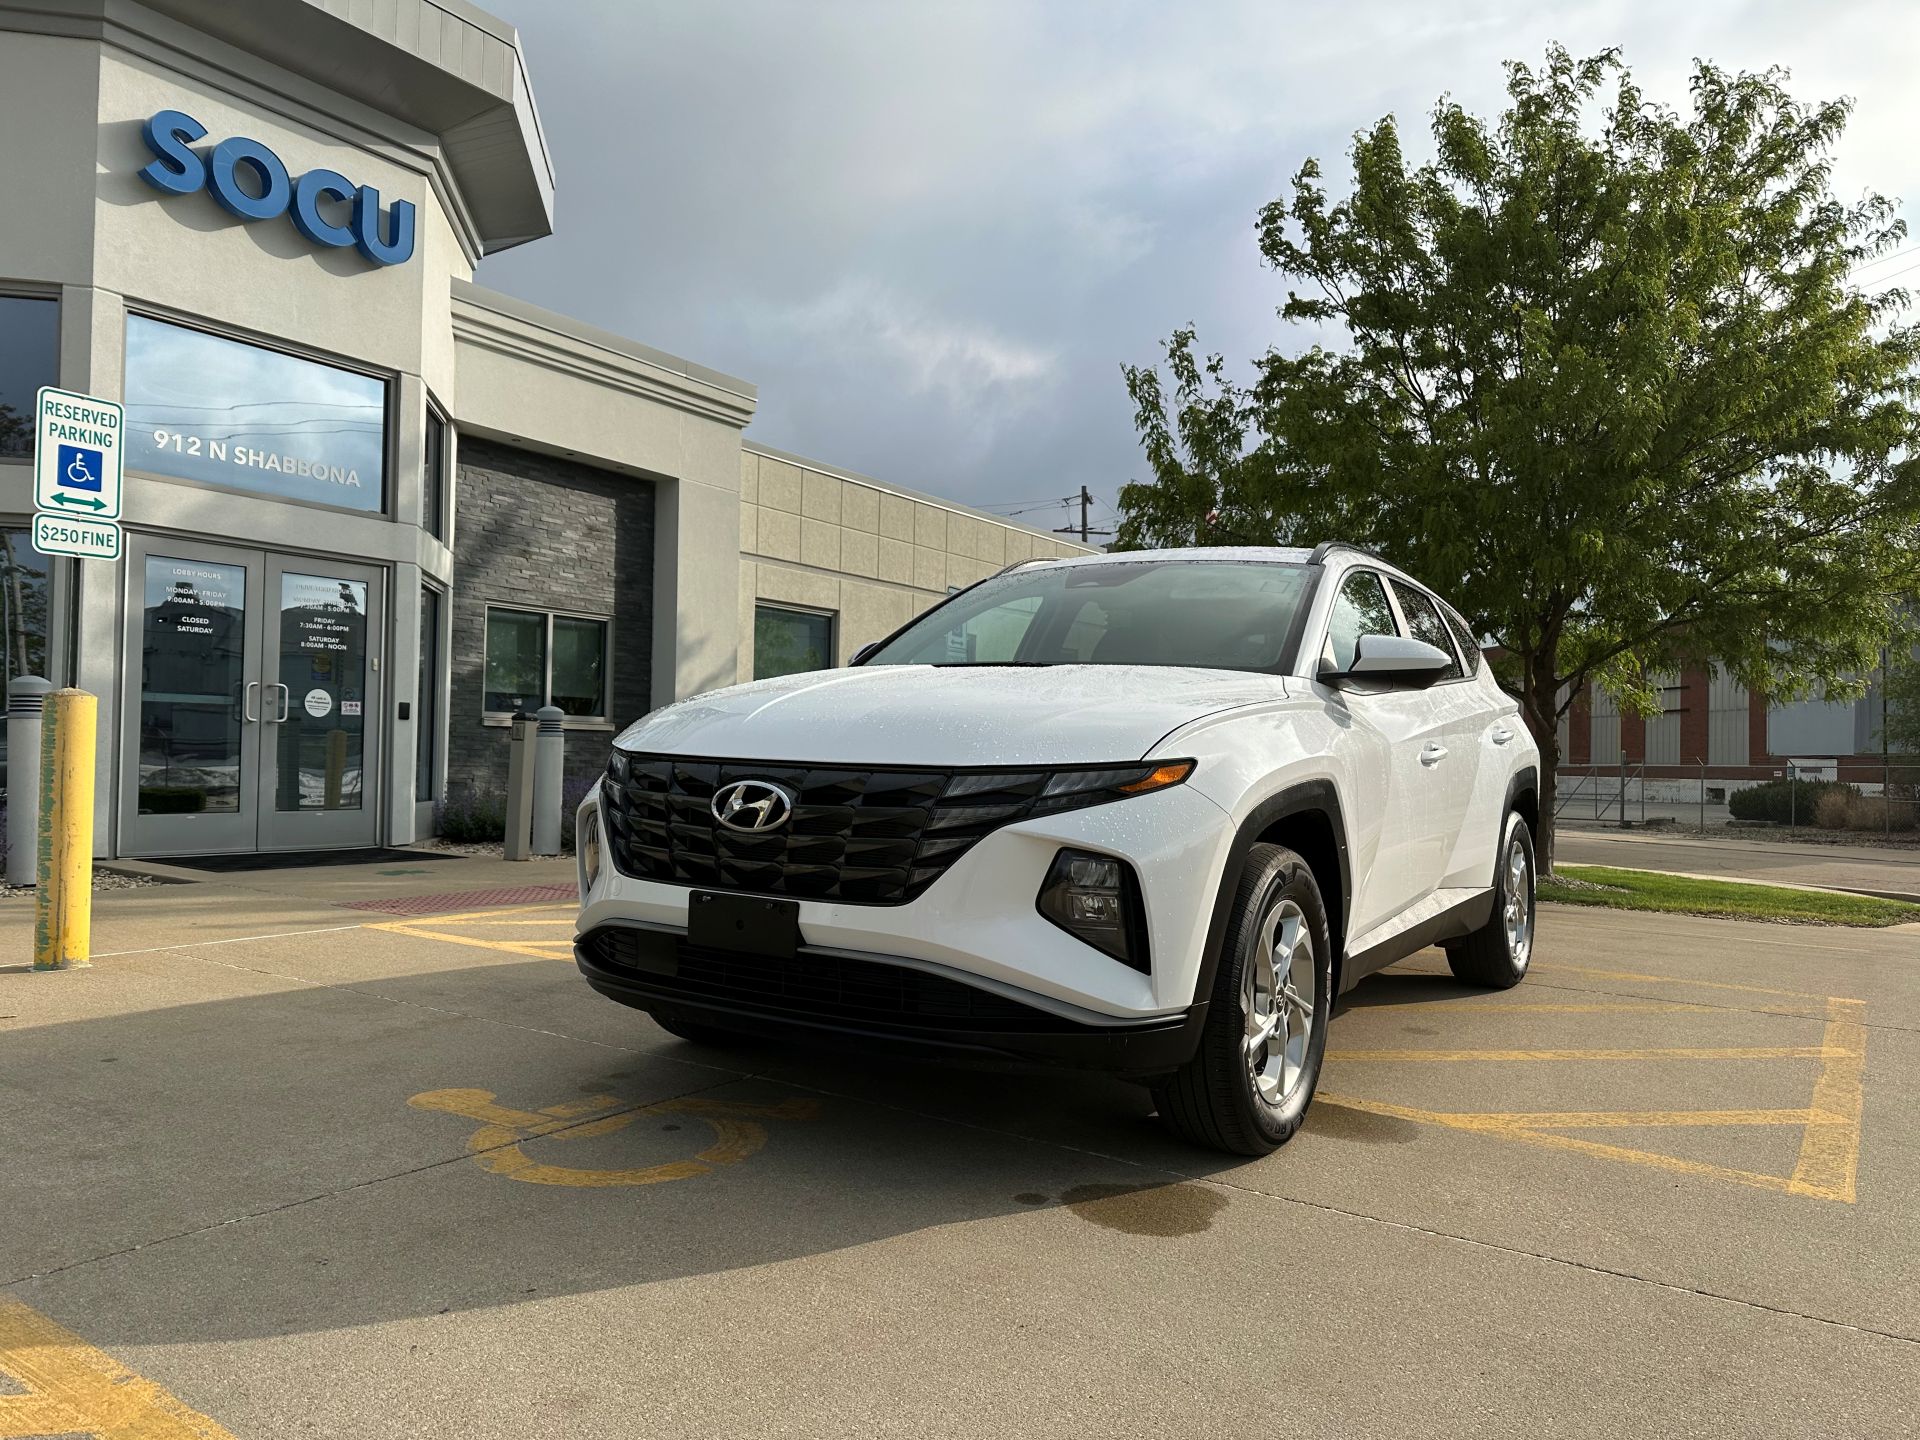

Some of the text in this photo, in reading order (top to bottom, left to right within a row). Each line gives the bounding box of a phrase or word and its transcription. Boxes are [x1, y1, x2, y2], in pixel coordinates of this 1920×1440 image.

[137, 109, 415, 266] SOCU
[45, 400, 118, 429] RESERVED
[49, 422, 113, 448] PARKING
[153, 429, 361, 488] 912 N SHABBONA
[40, 524, 115, 548] $250 FINE
[172, 568, 221, 580] LOBBY HOURS
[165, 586, 198, 595] MONDAY
[202, 590, 227, 598] FRIDAY
[167, 596, 194, 604] 9:00AM
[199, 599, 225, 608] 5:00PM
[181, 616, 209, 625] CLOSED
[299, 622, 323, 630] 7:30AM
[177, 625, 213, 634] SATURDAY
[308, 635, 340, 643] SATURDAY
